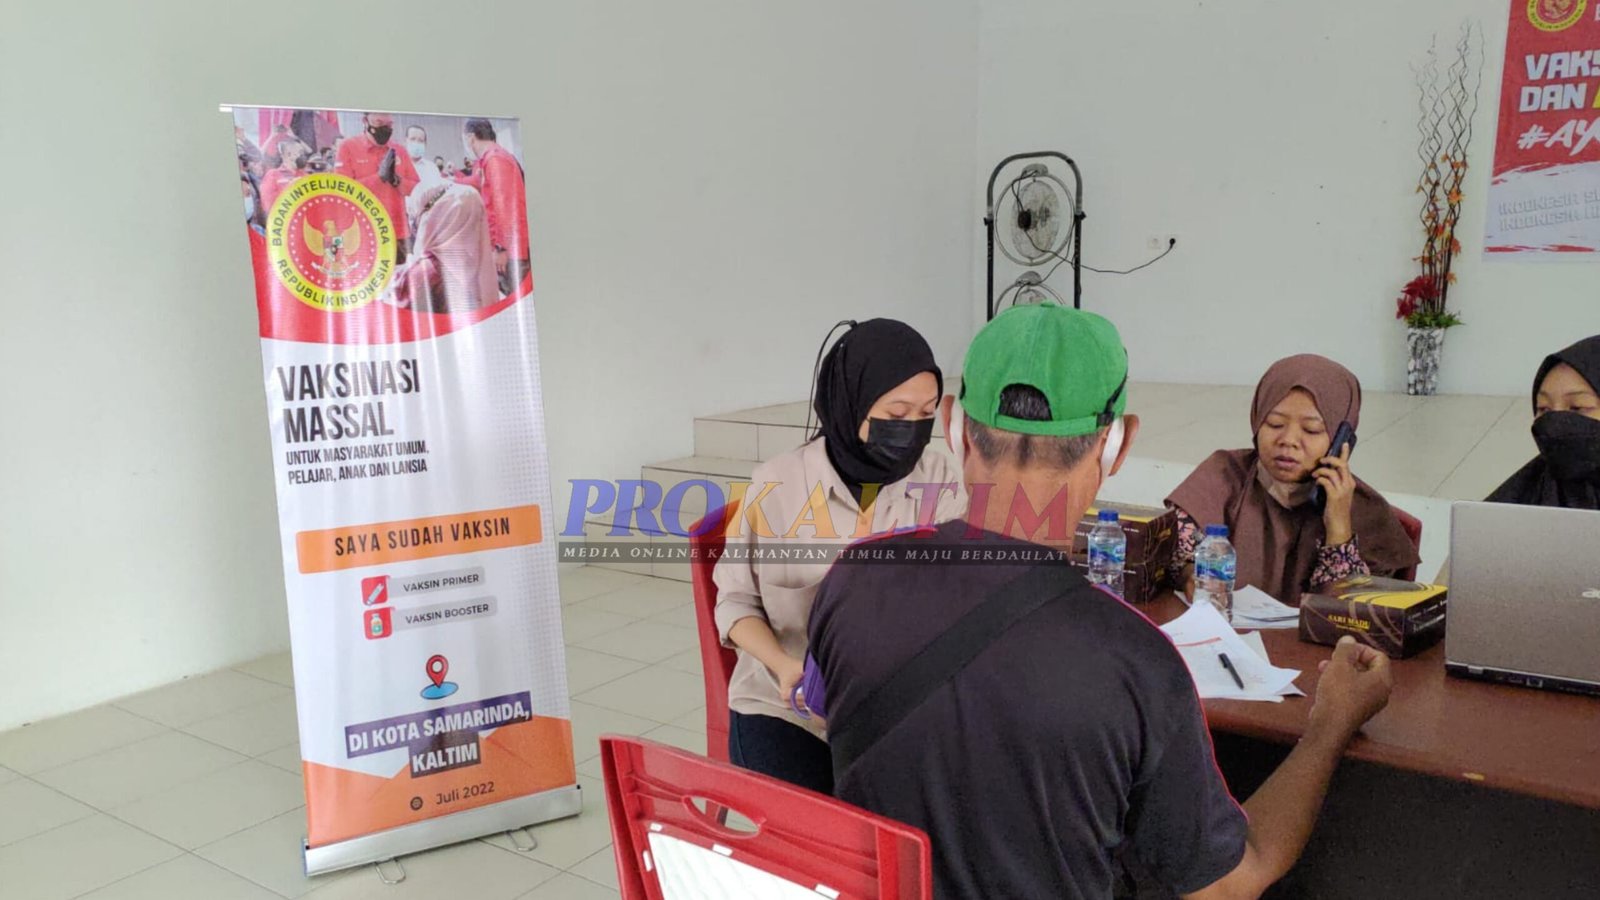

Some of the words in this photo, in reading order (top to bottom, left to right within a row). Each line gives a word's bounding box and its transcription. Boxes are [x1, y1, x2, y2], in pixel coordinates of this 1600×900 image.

[1519, 83, 1587, 111] DAN
[272, 199, 292, 246] BADAN
[290, 178, 355, 202] INTELIJEN
[356, 191, 390, 245] NEGARA
[277, 259, 335, 306] REPUBLIK
[336, 259, 391, 306] INDONESIA
[276, 358, 421, 402] VAKSINASI
[283, 401, 395, 444] MASSAL
[286, 448, 322, 466] UNTUK
[323, 442, 393, 464] MASYARAKAT
[288, 466, 337, 485] PELAJAR,
[338, 463, 368, 480] ANAK
[369, 462, 391, 477] DAN
[392, 459, 428, 476] LANSIA
[335, 531, 381, 557] SAYA
[388, 524, 444, 550] SUDAH
[450, 516, 511, 543] VAKSIN
[403, 580, 440, 593] VAKSIN
[442, 573, 480, 587] PRIMER
[405, 611, 442, 624] VAKSIN
[444, 603, 490, 619] BOOSTER
[348, 734, 369, 752] DI
[372, 723, 421, 746] KOTA
[423, 700, 531, 736] SAMARINDA,
[411, 742, 478, 773] KALTIM
[435, 792, 460, 806] Juli
[463, 782, 495, 801] 2022
